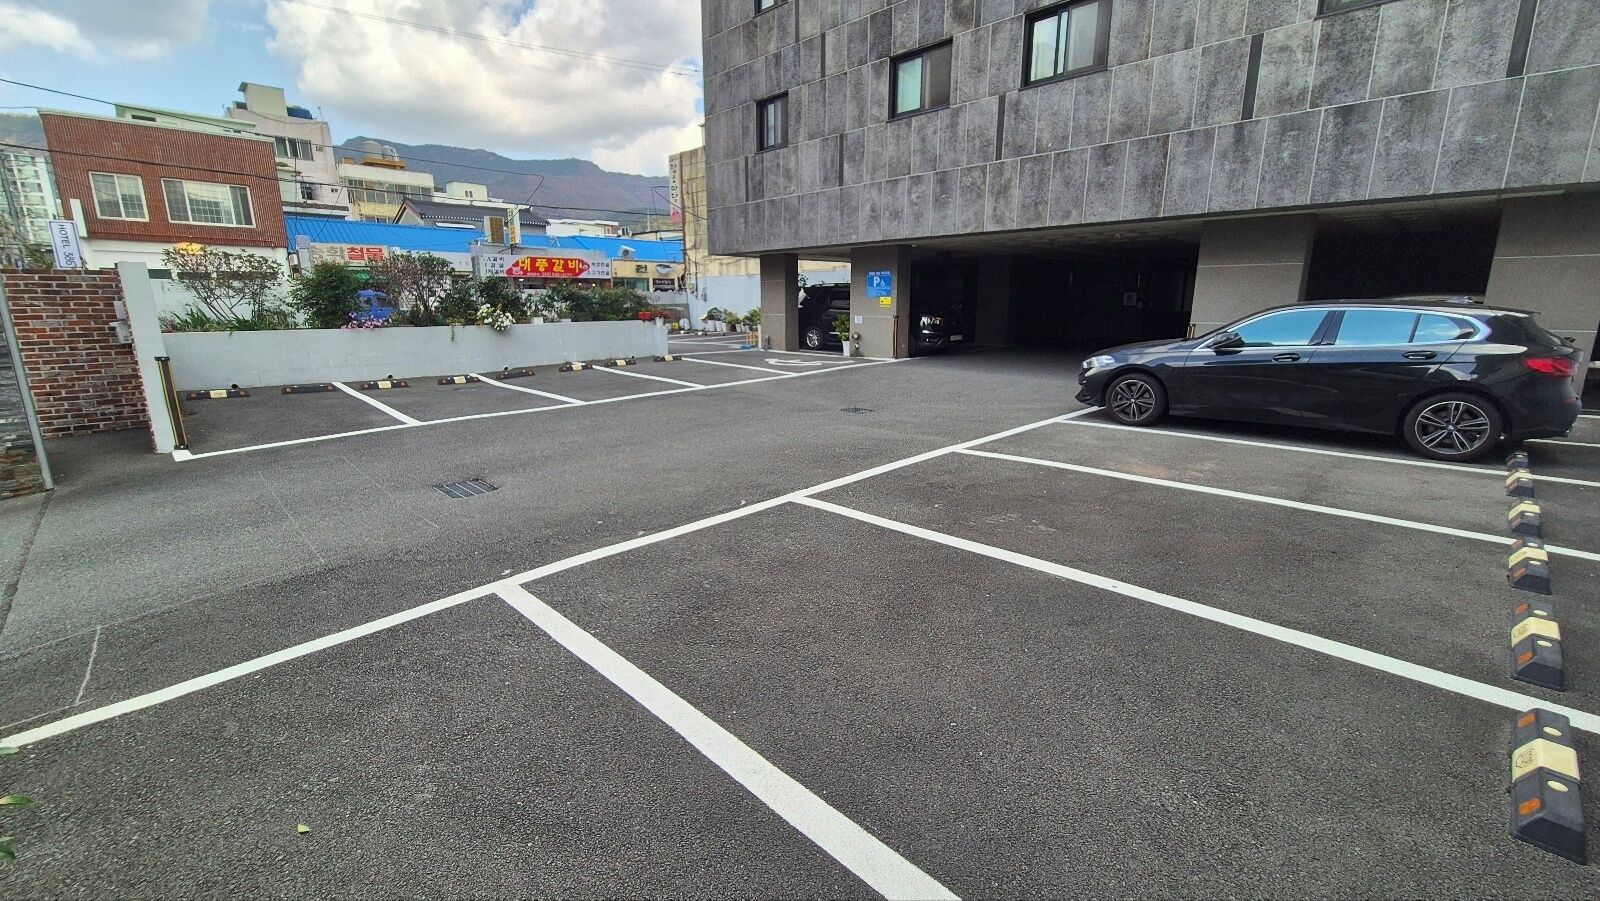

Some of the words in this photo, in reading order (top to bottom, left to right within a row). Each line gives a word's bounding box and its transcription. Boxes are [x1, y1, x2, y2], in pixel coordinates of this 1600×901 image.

[58, 224, 70, 248] HOTEL
[519, 257, 580, 274] 대풍갈비
[873, 276, 880, 286] P
